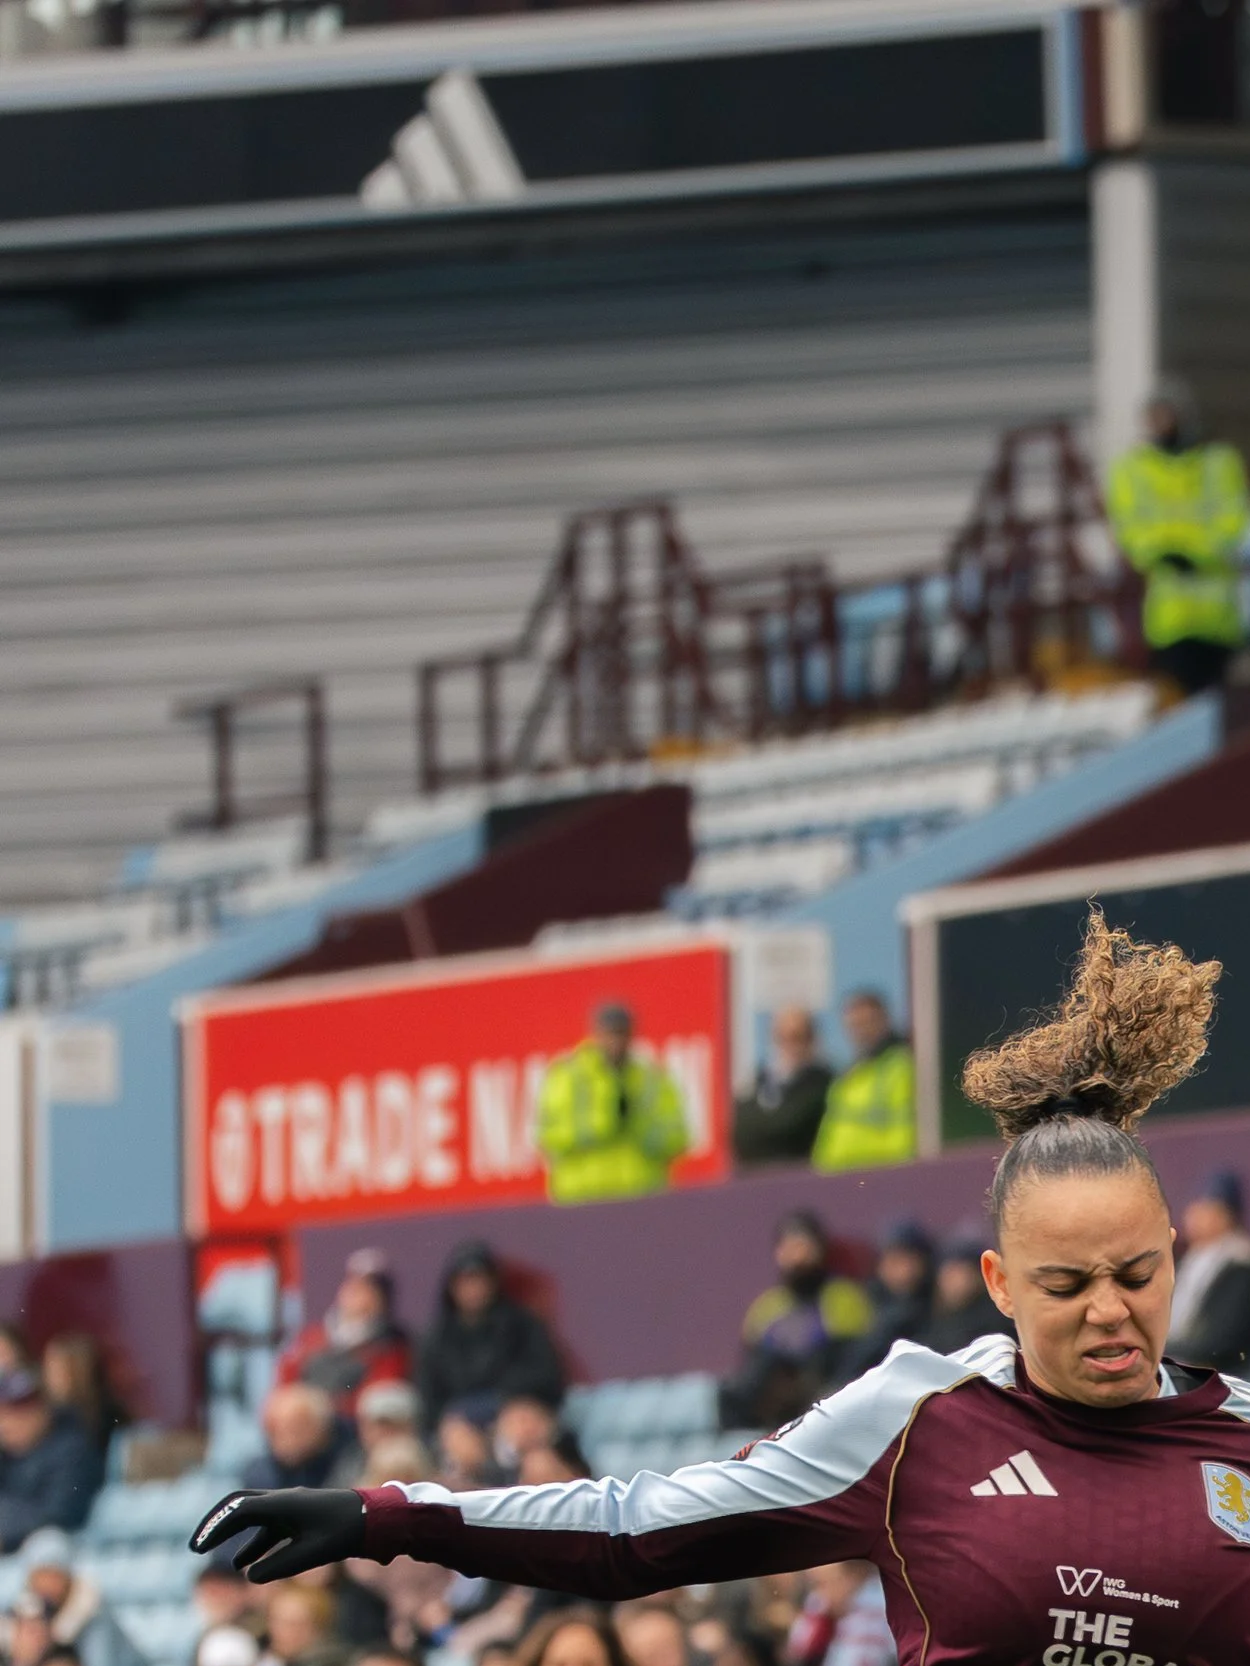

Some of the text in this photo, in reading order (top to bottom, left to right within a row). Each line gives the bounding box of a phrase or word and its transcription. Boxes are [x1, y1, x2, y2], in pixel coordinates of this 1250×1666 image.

[251, 1062, 461, 1207] TRADE
[1103, 1577, 1125, 1589] IWG
[1103, 1586, 1180, 1609] Women & Sport
[1048, 1608, 1133, 1648] THE
